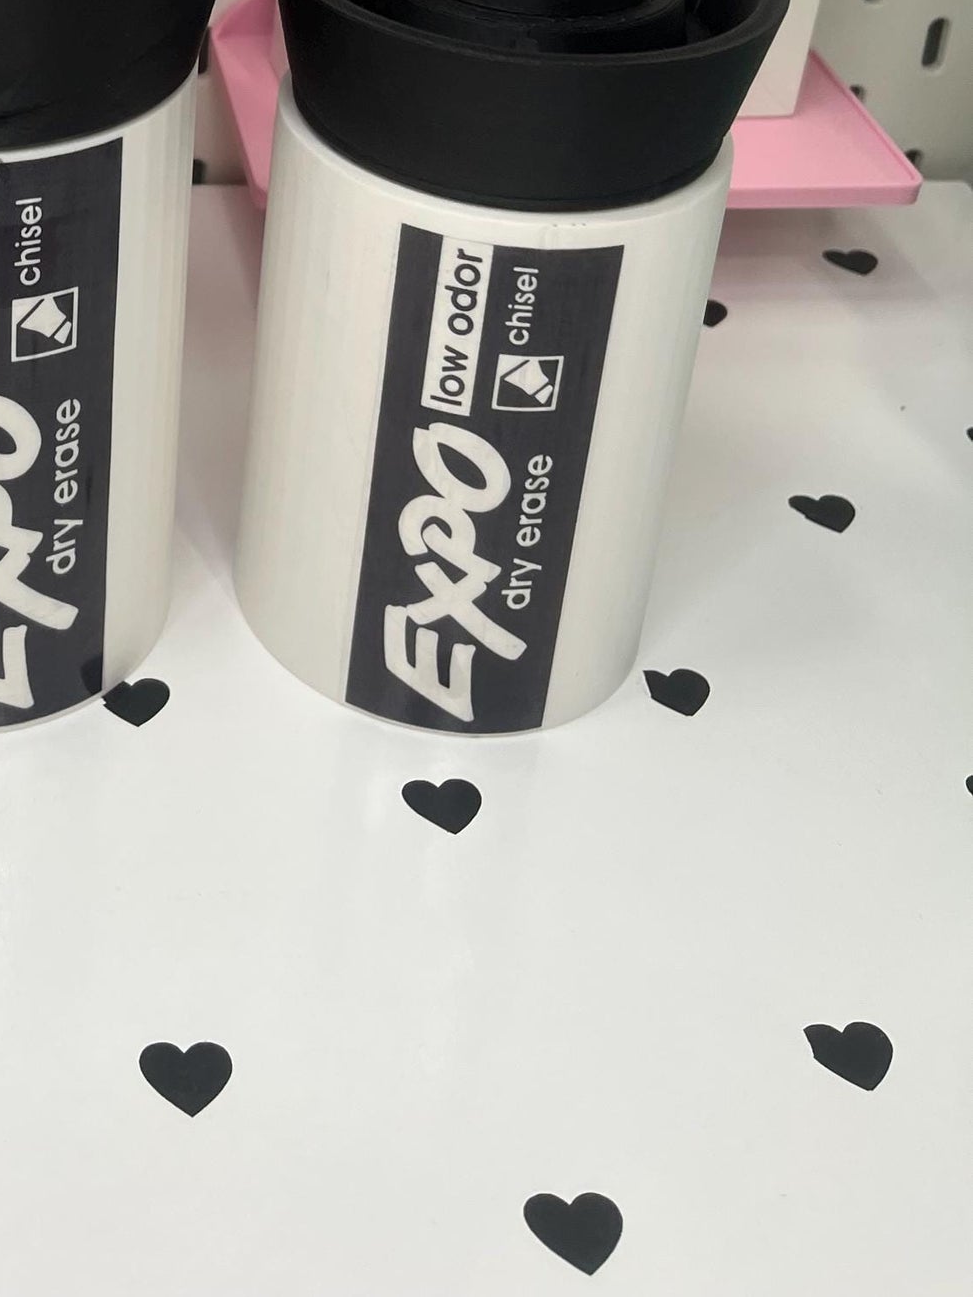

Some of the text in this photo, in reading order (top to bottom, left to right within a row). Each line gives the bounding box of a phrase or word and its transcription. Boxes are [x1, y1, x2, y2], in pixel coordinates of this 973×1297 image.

[14, 197, 42, 286] chisel
[505, 266, 539, 346] chisel
[430, 248, 483, 407] low odor
[46, 398, 83, 575] dry erase
[501, 454, 553, 610] dry erase
